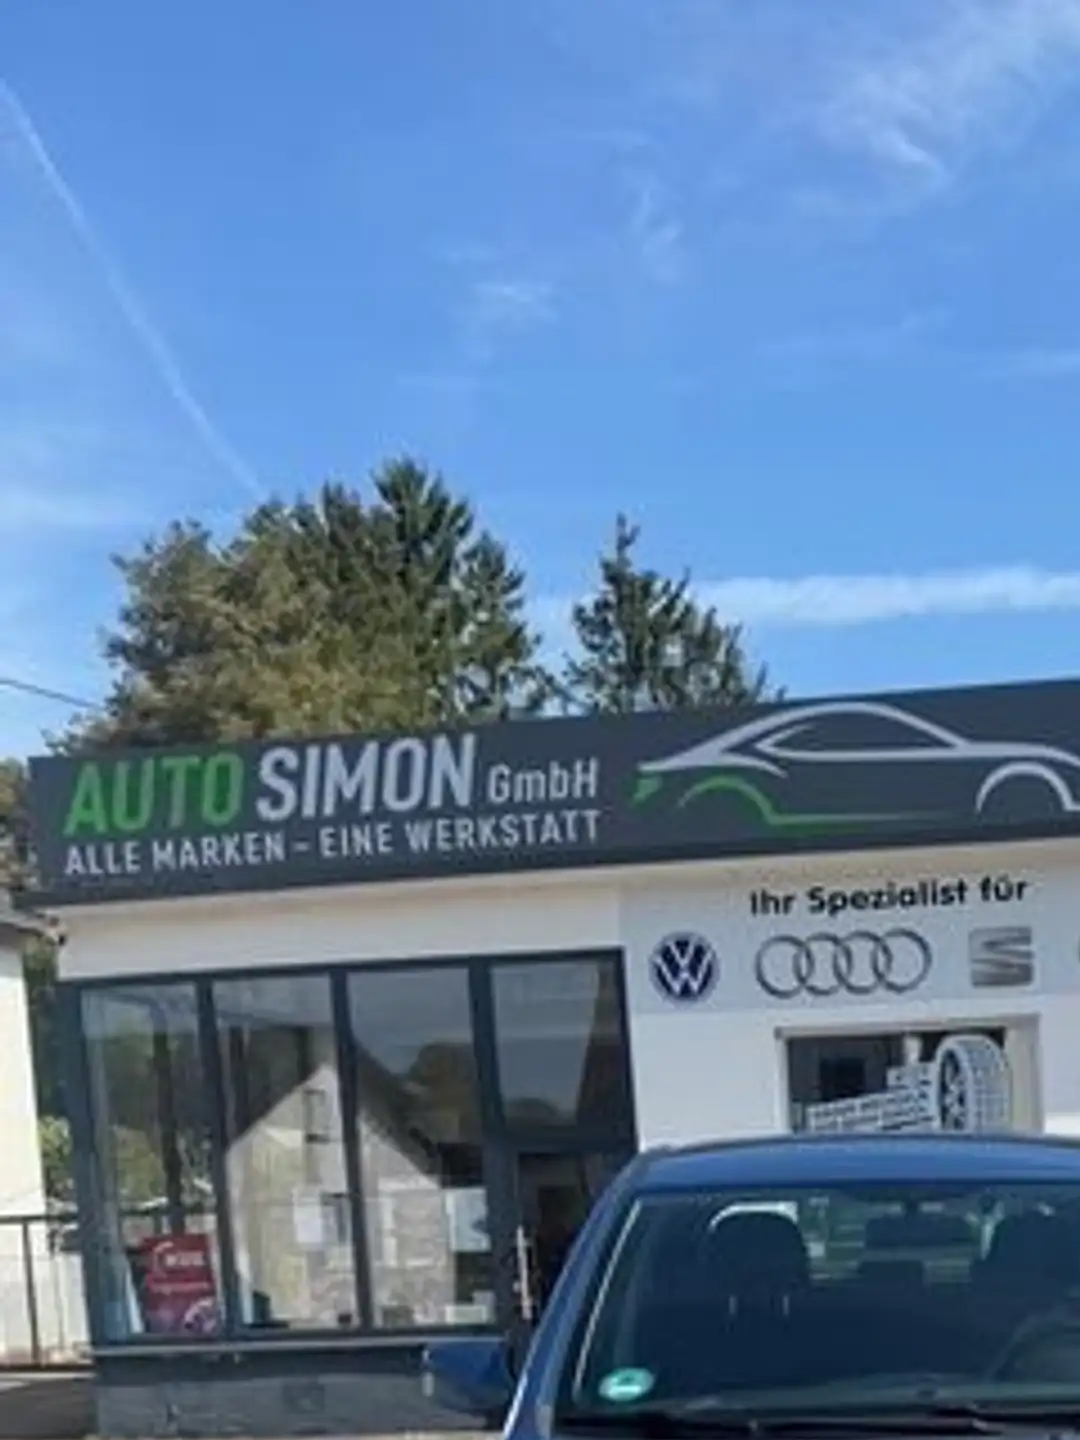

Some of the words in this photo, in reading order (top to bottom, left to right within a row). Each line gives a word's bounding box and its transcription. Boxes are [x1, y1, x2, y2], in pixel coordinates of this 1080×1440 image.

[64, 753, 244, 835] AUTO
[257, 733, 476, 821] SIMON
[488, 757, 598, 804] GmbH
[64, 840, 142, 875] ALLE
[151, 831, 285, 870] MARKEN
[320, 822, 394, 857] EINE
[405, 808, 601, 852] WERKSTATT
[750, 888, 796, 917] Ihr
[807, 877, 967, 917] Spezialist
[980, 874, 1028, 901] für
